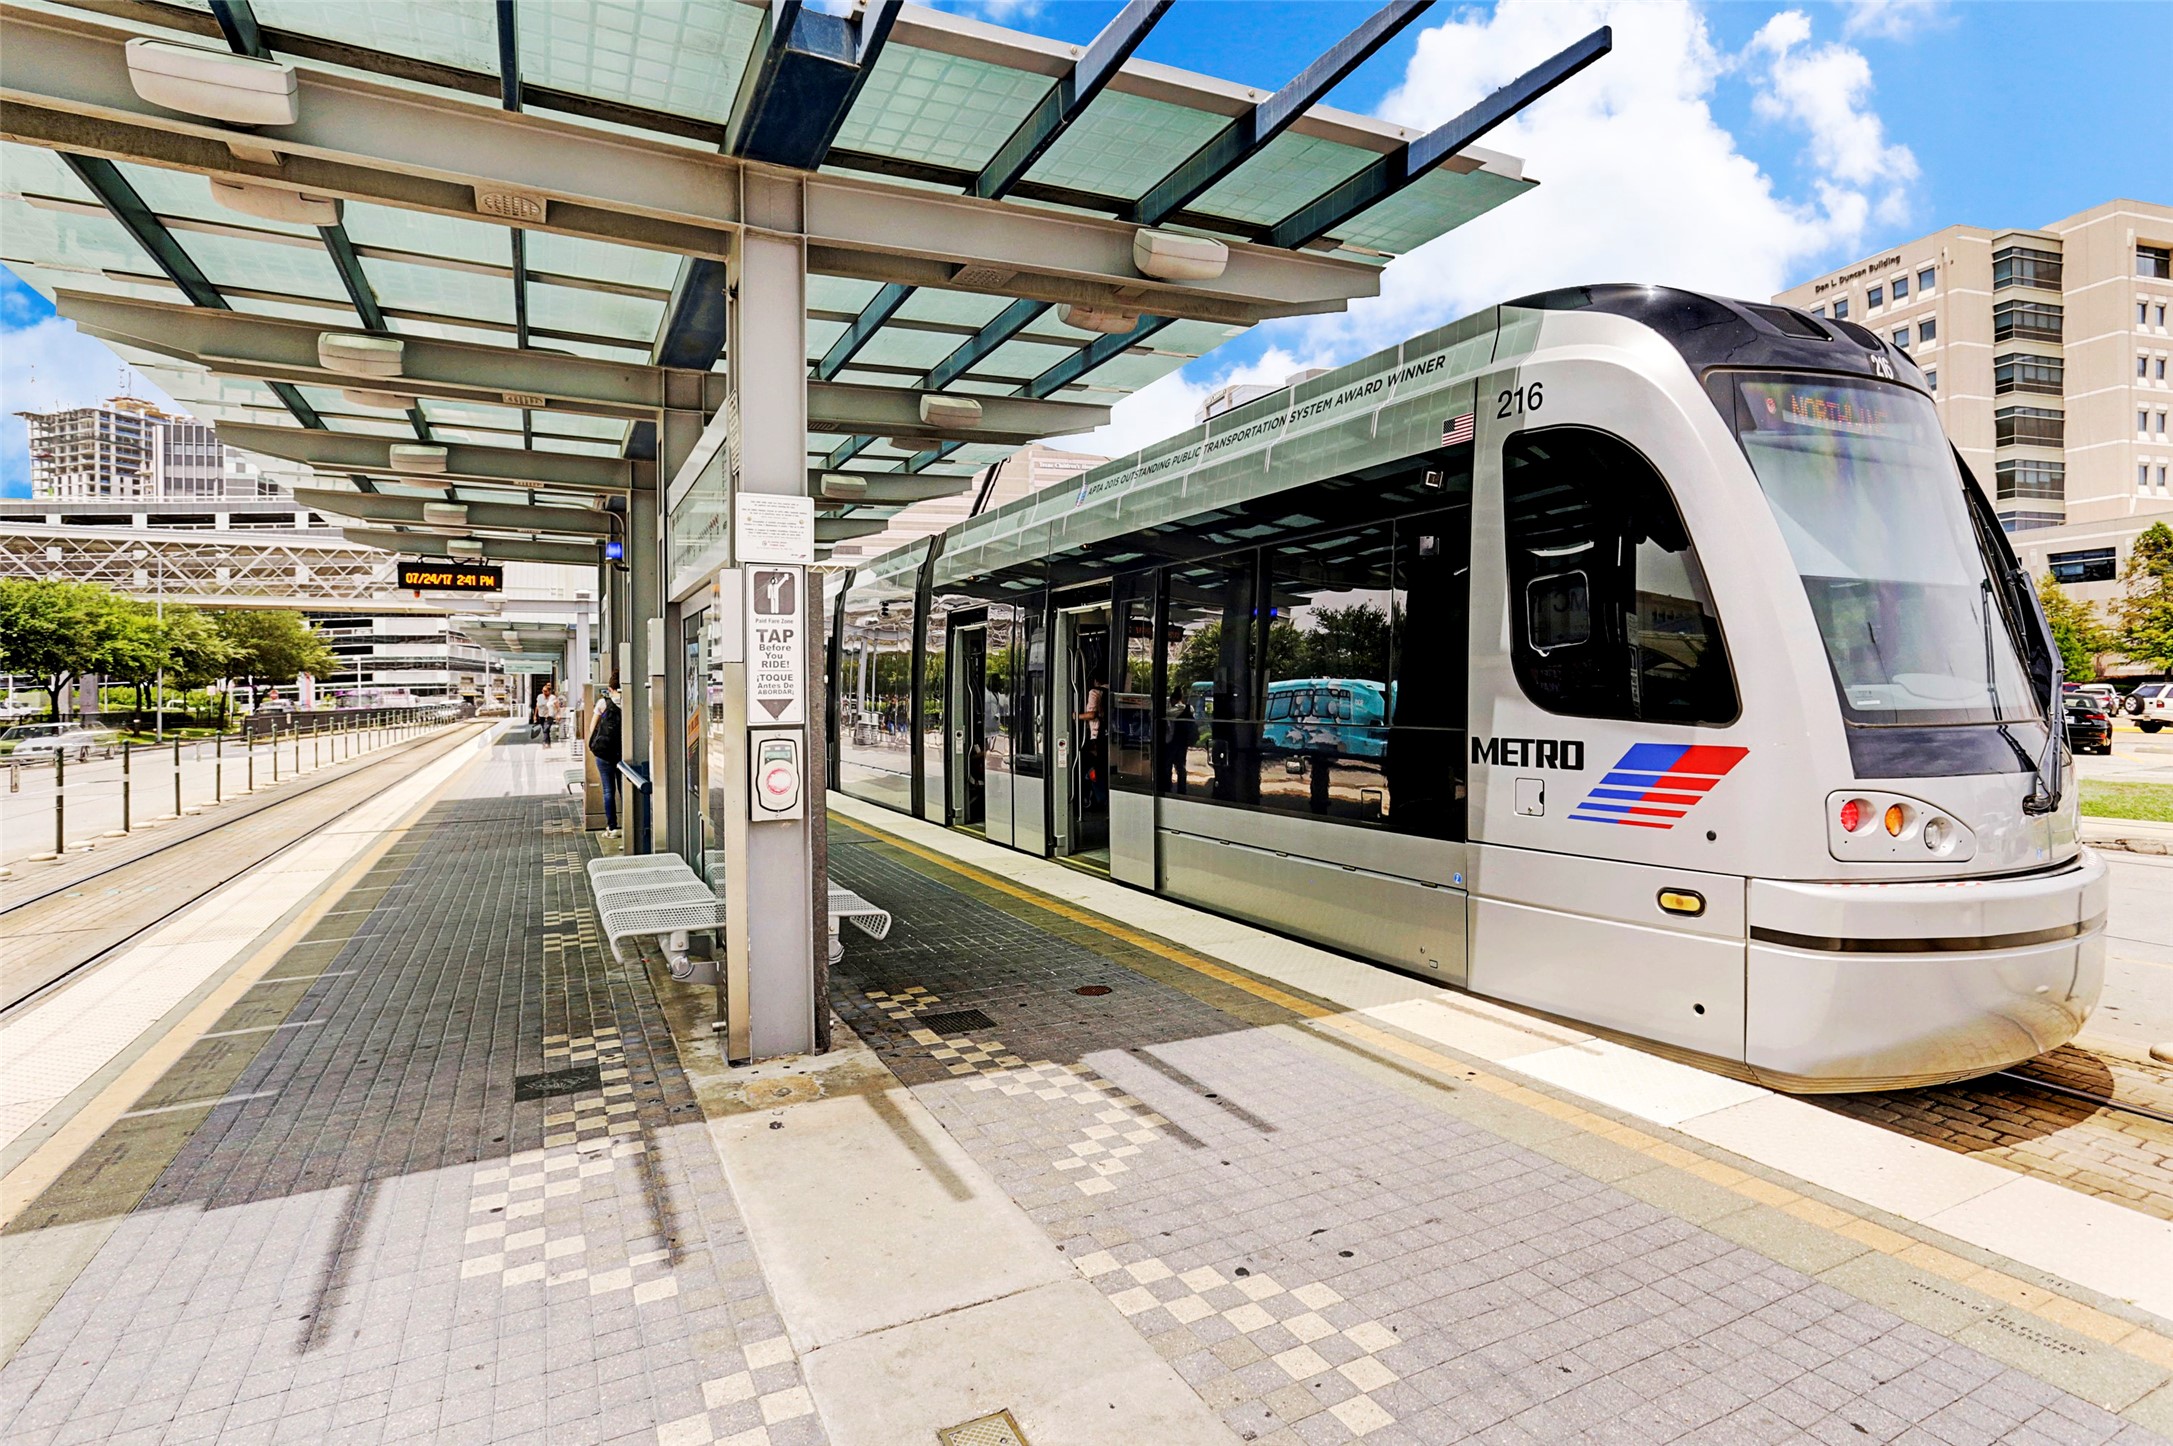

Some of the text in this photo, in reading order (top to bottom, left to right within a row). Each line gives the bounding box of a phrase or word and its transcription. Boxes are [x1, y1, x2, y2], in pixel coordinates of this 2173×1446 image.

[1839, 269, 1867, 284] Duncan
[1869, 255, 1901, 273] Building
[1870, 354, 1894, 380] 216
[1497, 382, 1543, 419] 216
[1088, 355, 1446, 496] APTA 2015 OUTSTANDING PUBLIC TRANSPORTATION SYSTEM AWARD WINNER
[405, 572, 495, 586] 07/24/17 2:41 PM
[756, 628, 794, 643] TAP
[759, 643, 791, 651] Before
[761, 660, 790, 668] RIDE!
[756, 674, 793, 682] ¡TOQUE
[1471, 736, 1584, 771] METRO
